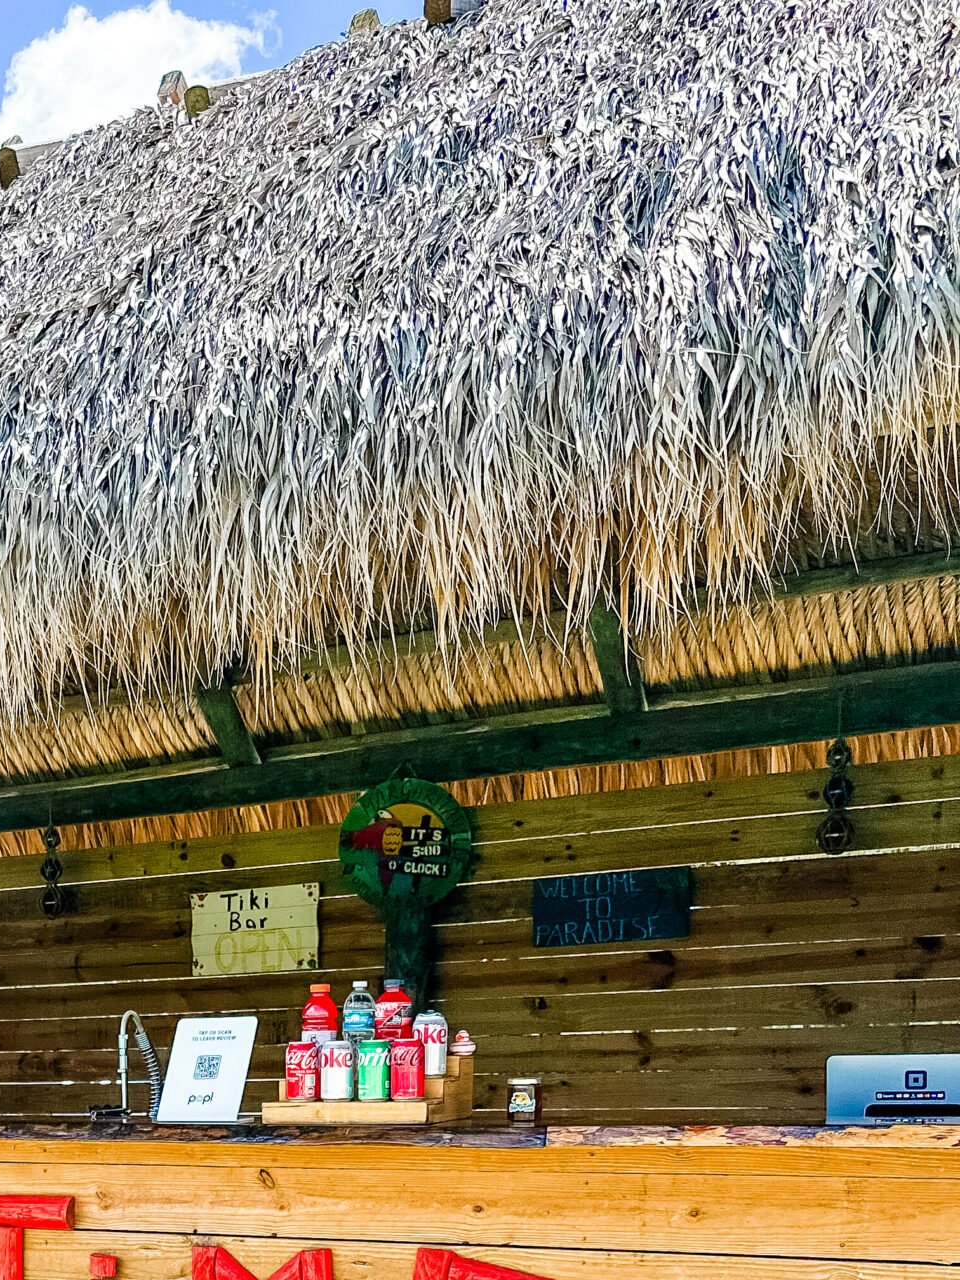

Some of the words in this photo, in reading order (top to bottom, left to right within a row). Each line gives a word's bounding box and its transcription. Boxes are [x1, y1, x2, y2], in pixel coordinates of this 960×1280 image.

[410, 828, 442, 841] IT'S
[412, 844, 441, 857] 5:00
[538, 871, 641, 898] WELCOME
[219, 889, 270, 912] Tiki
[577, 896, 611, 920] TO
[229, 911, 268, 932] Bar
[536, 915, 661, 946] PARADISE
[213, 928, 302, 974] OPEN
[412, 1023, 447, 1044] oke
[320, 1047, 353, 1069] oke
